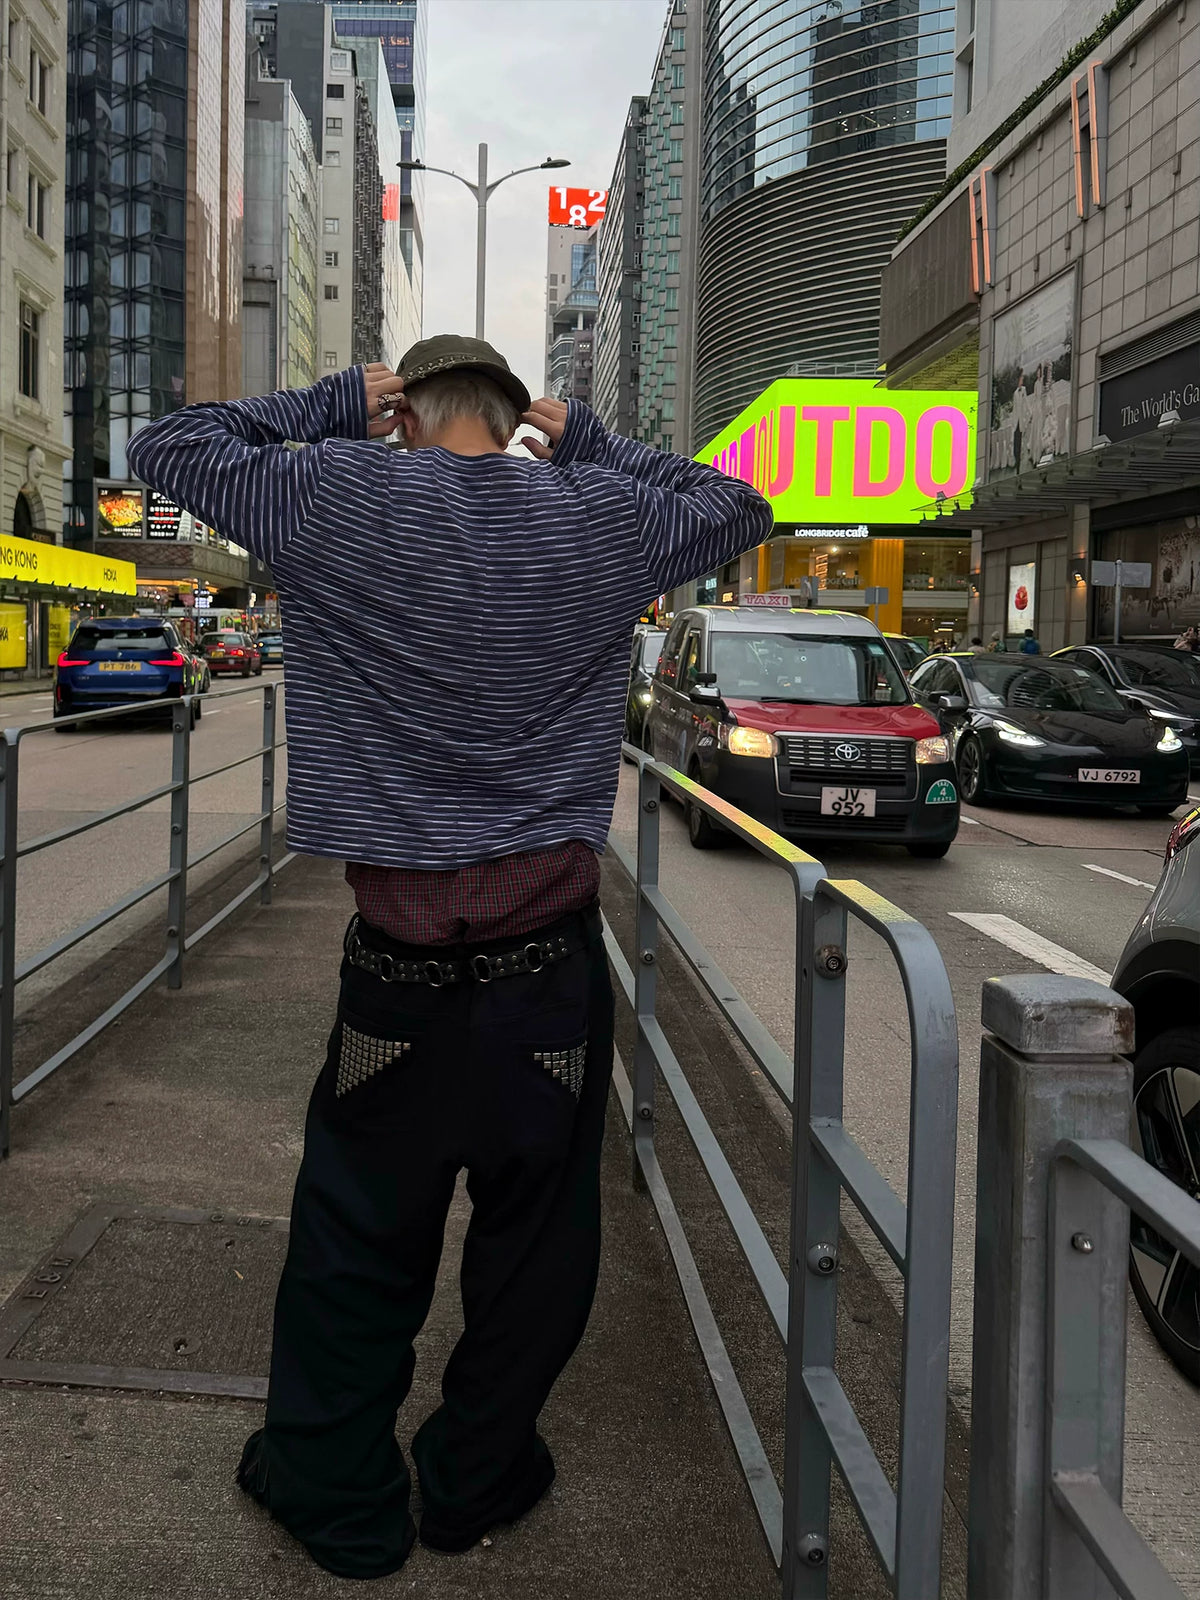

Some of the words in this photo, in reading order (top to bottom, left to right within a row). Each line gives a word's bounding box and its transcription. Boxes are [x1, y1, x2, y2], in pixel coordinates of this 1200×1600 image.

[1121, 406, 1140, 427] The
[1141, 390, 1181, 419] World's
[795, 528, 846, 538] LONGBRIDGE
[846, 525, 869, 538] café
[14, 549, 38, 570] KONG
[103, 568, 117, 582] HOKA
[744, 595, 789, 606] TAXI
[1082, 771, 1099, 781] VJ
[1104, 772, 1137, 782] 6792
[839, 788, 860, 803] JV
[940, 787, 947, 796] 4
[832, 802, 865, 816] 952
